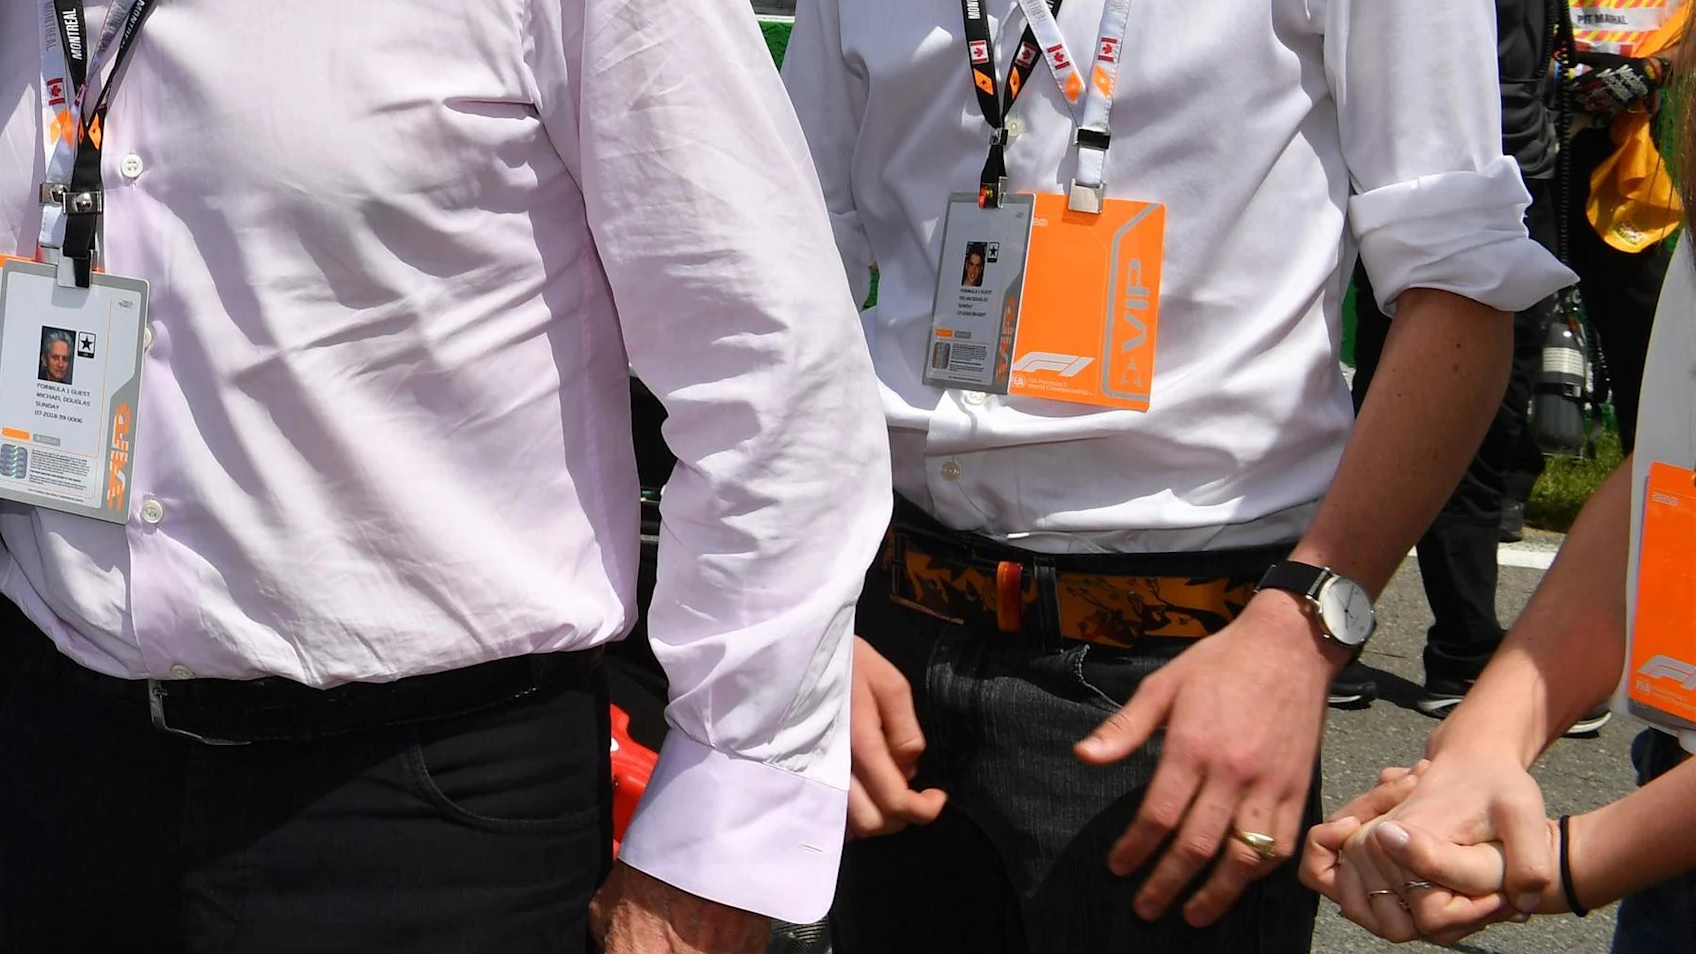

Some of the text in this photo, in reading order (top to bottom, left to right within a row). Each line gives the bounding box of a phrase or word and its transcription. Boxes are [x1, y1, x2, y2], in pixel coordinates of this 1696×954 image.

[64, 7, 83, 61] MONTREAL
[1120, 257, 1151, 353] VIP
[1011, 350, 1095, 378] F1
[35, 401, 60, 410] SUNDAY
[36, 392, 91, 407] MICHAEL DOUGLAS
